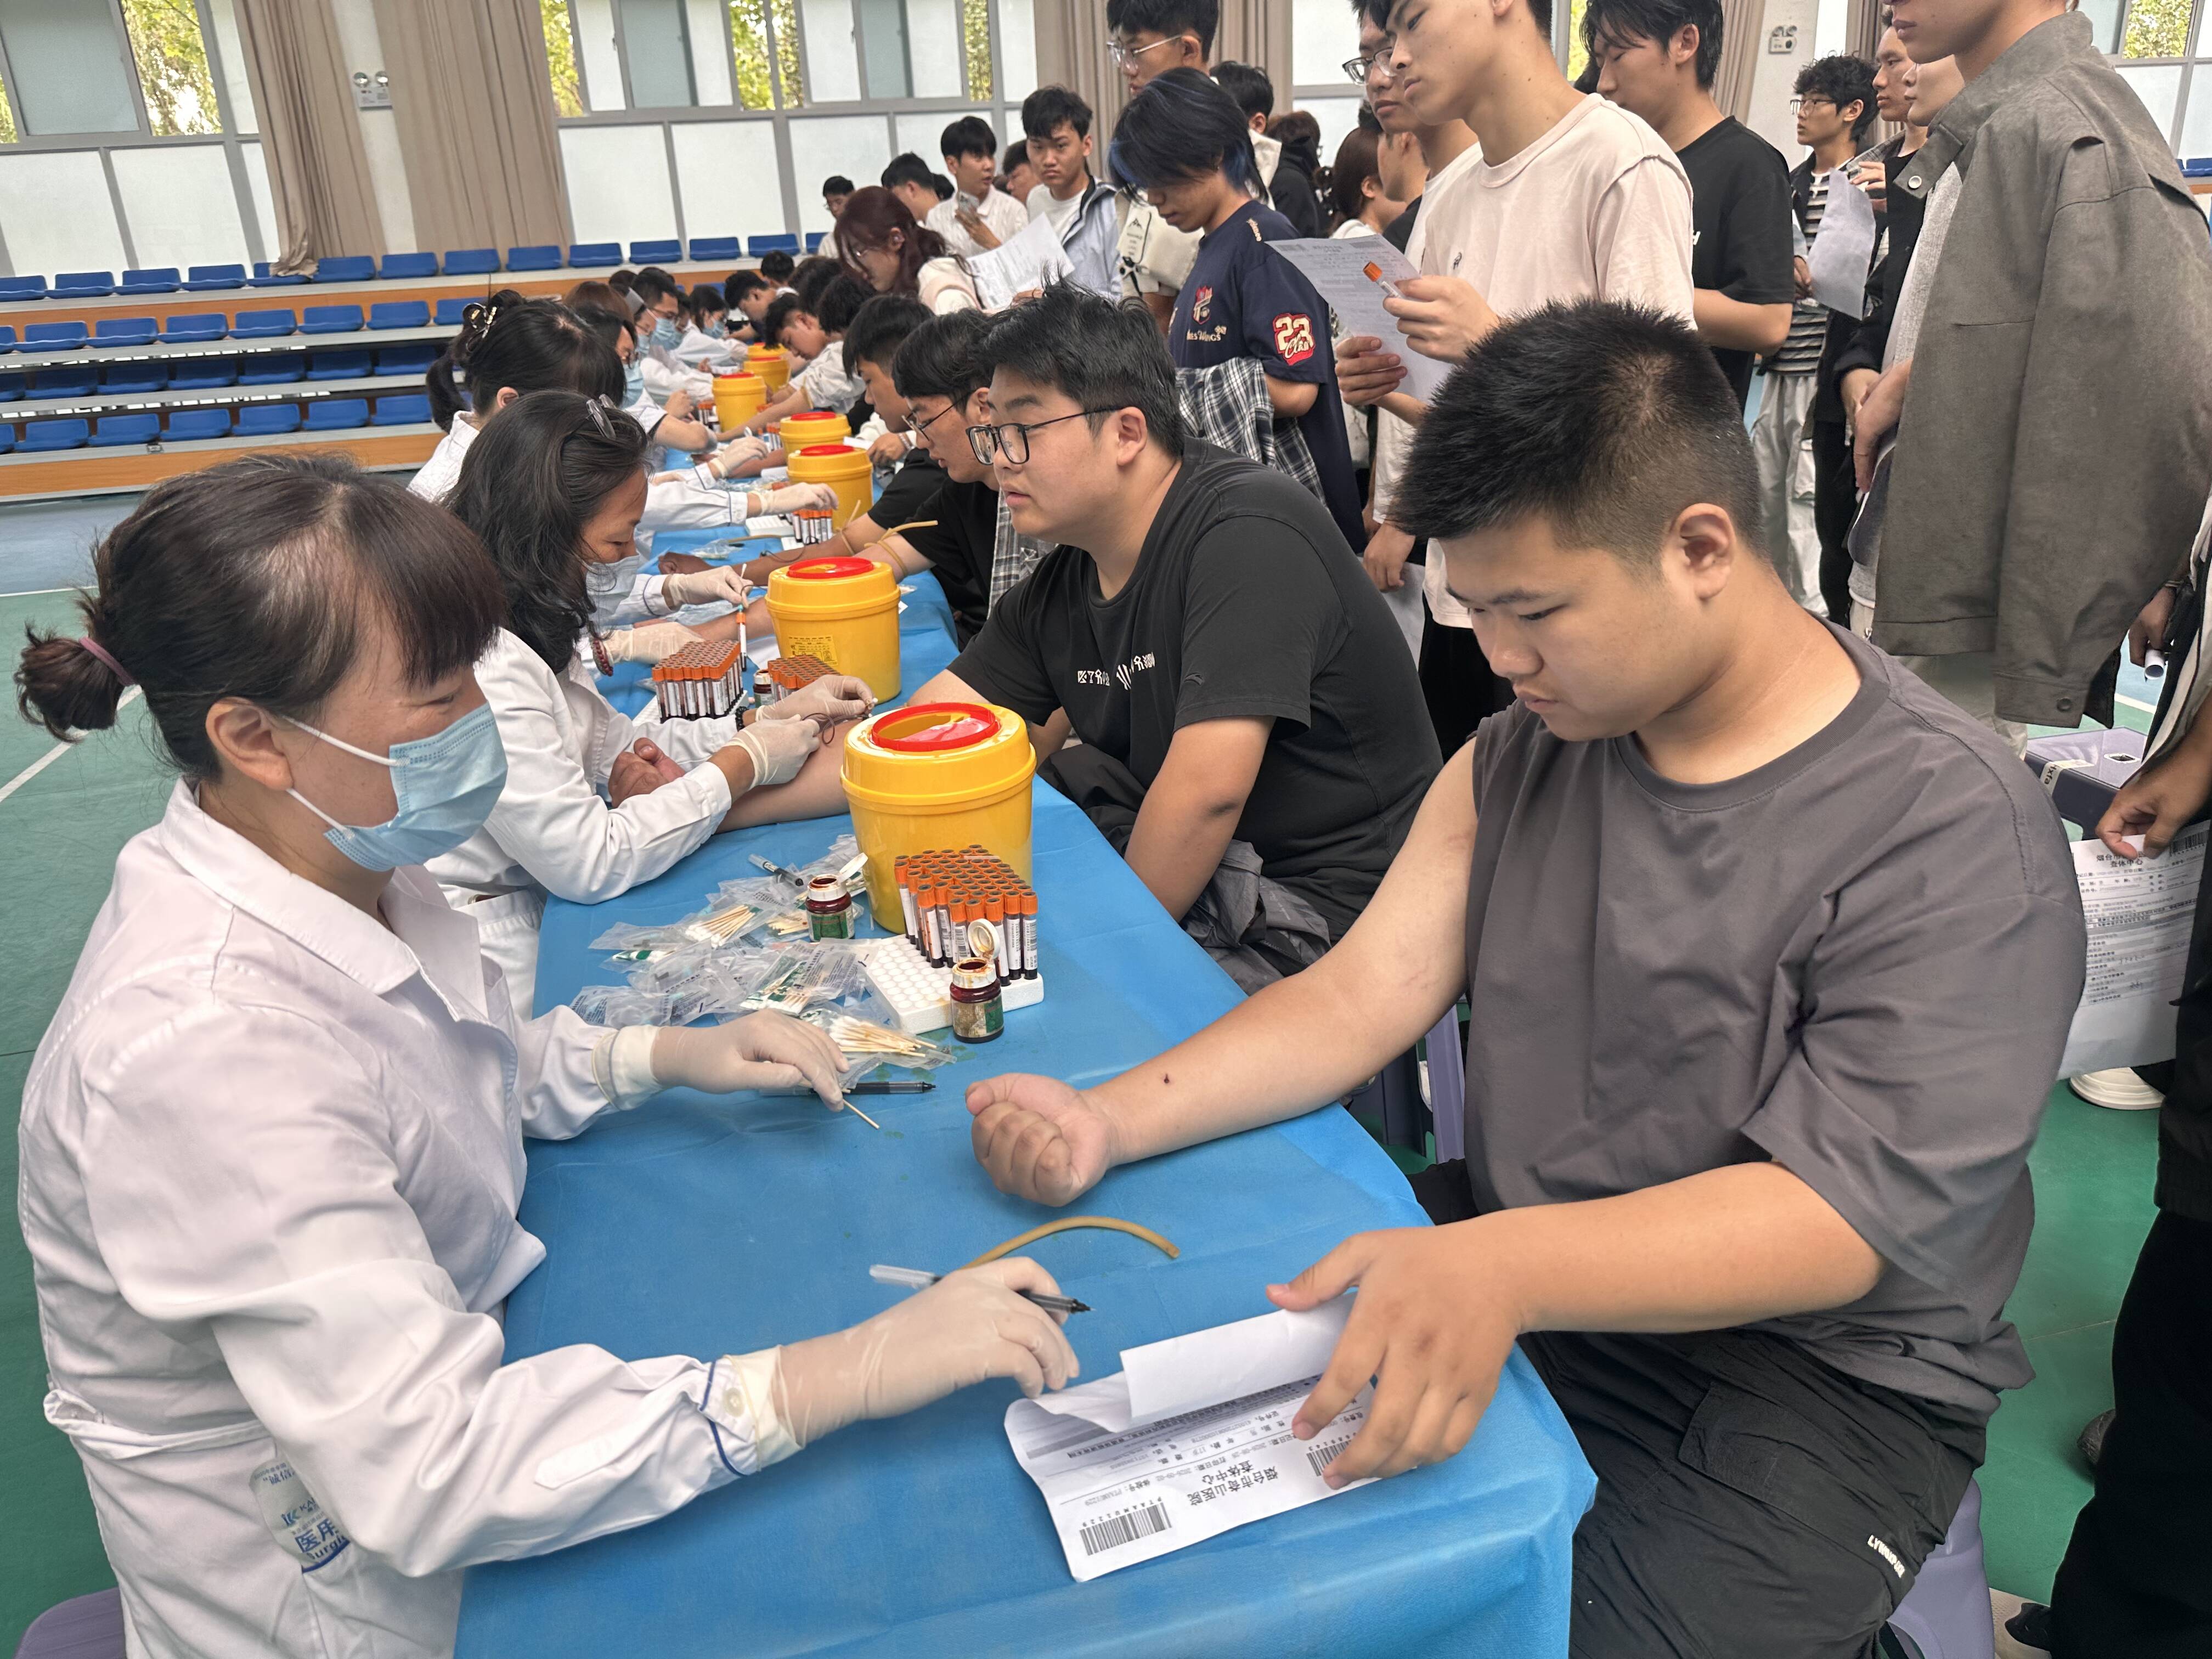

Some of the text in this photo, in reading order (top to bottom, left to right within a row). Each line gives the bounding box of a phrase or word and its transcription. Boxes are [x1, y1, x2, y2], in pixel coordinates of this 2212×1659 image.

[1276, 317, 1313, 351] 23
[1187, 1465, 1278, 1505] 烟台市奇山医院
[1202, 1460, 1254, 1485] 查体中心
